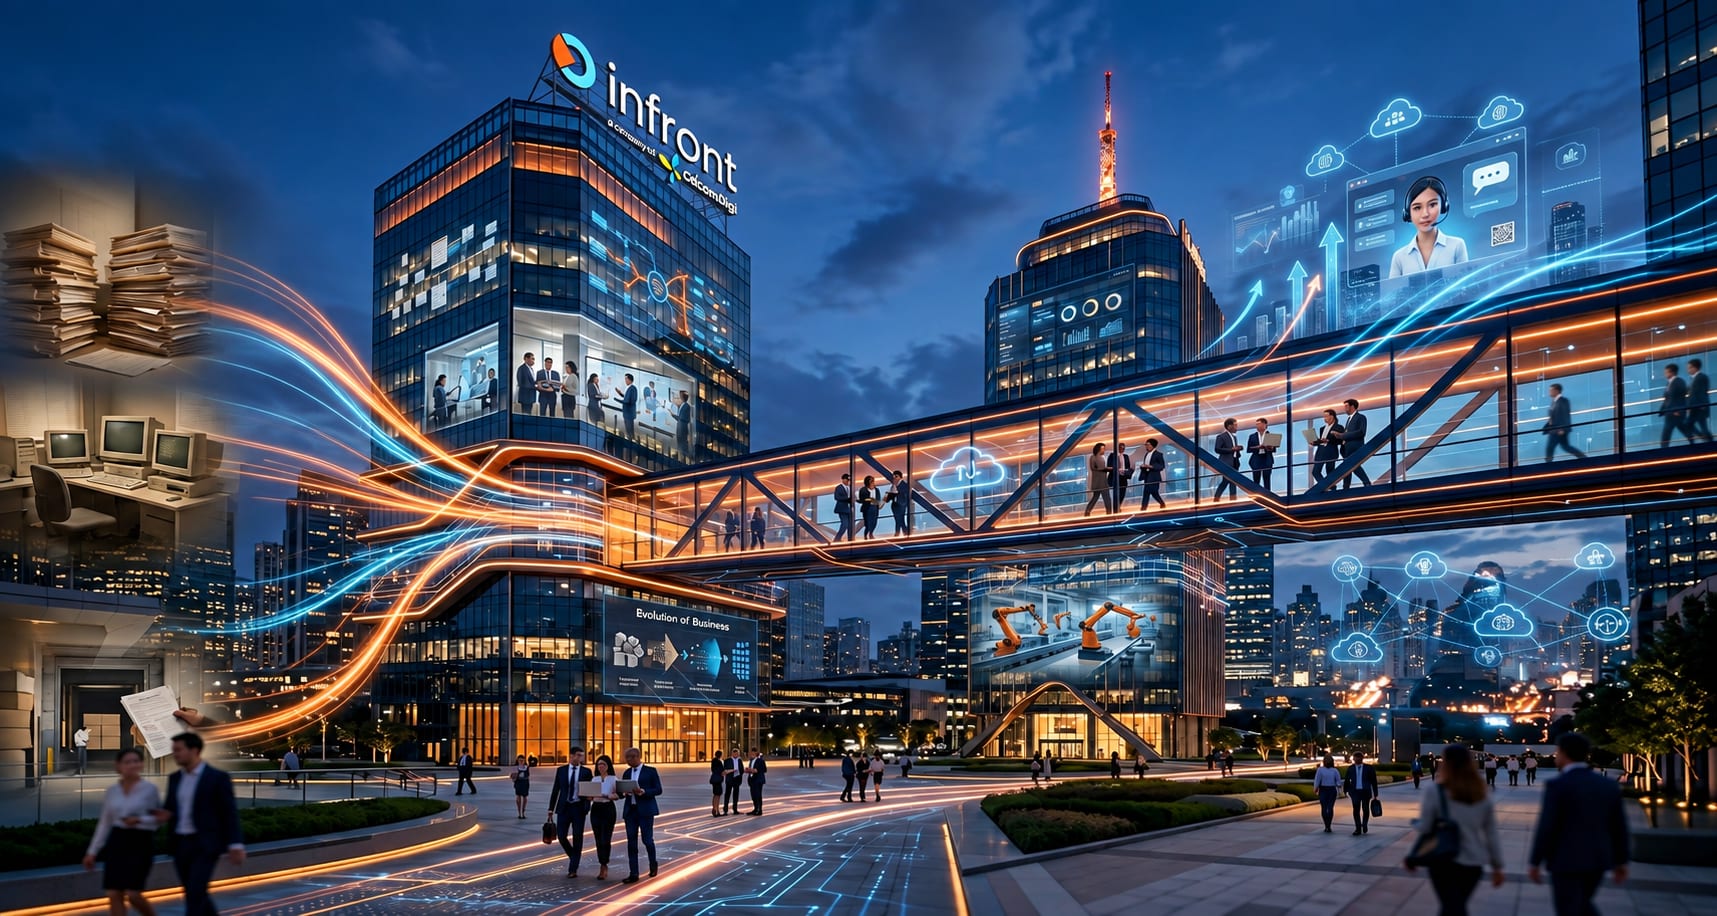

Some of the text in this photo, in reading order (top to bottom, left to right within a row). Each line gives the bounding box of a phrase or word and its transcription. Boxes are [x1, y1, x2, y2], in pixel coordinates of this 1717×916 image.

[607, 61, 738, 193] infront
[636, 607, 731, 632] Evolution of Business
